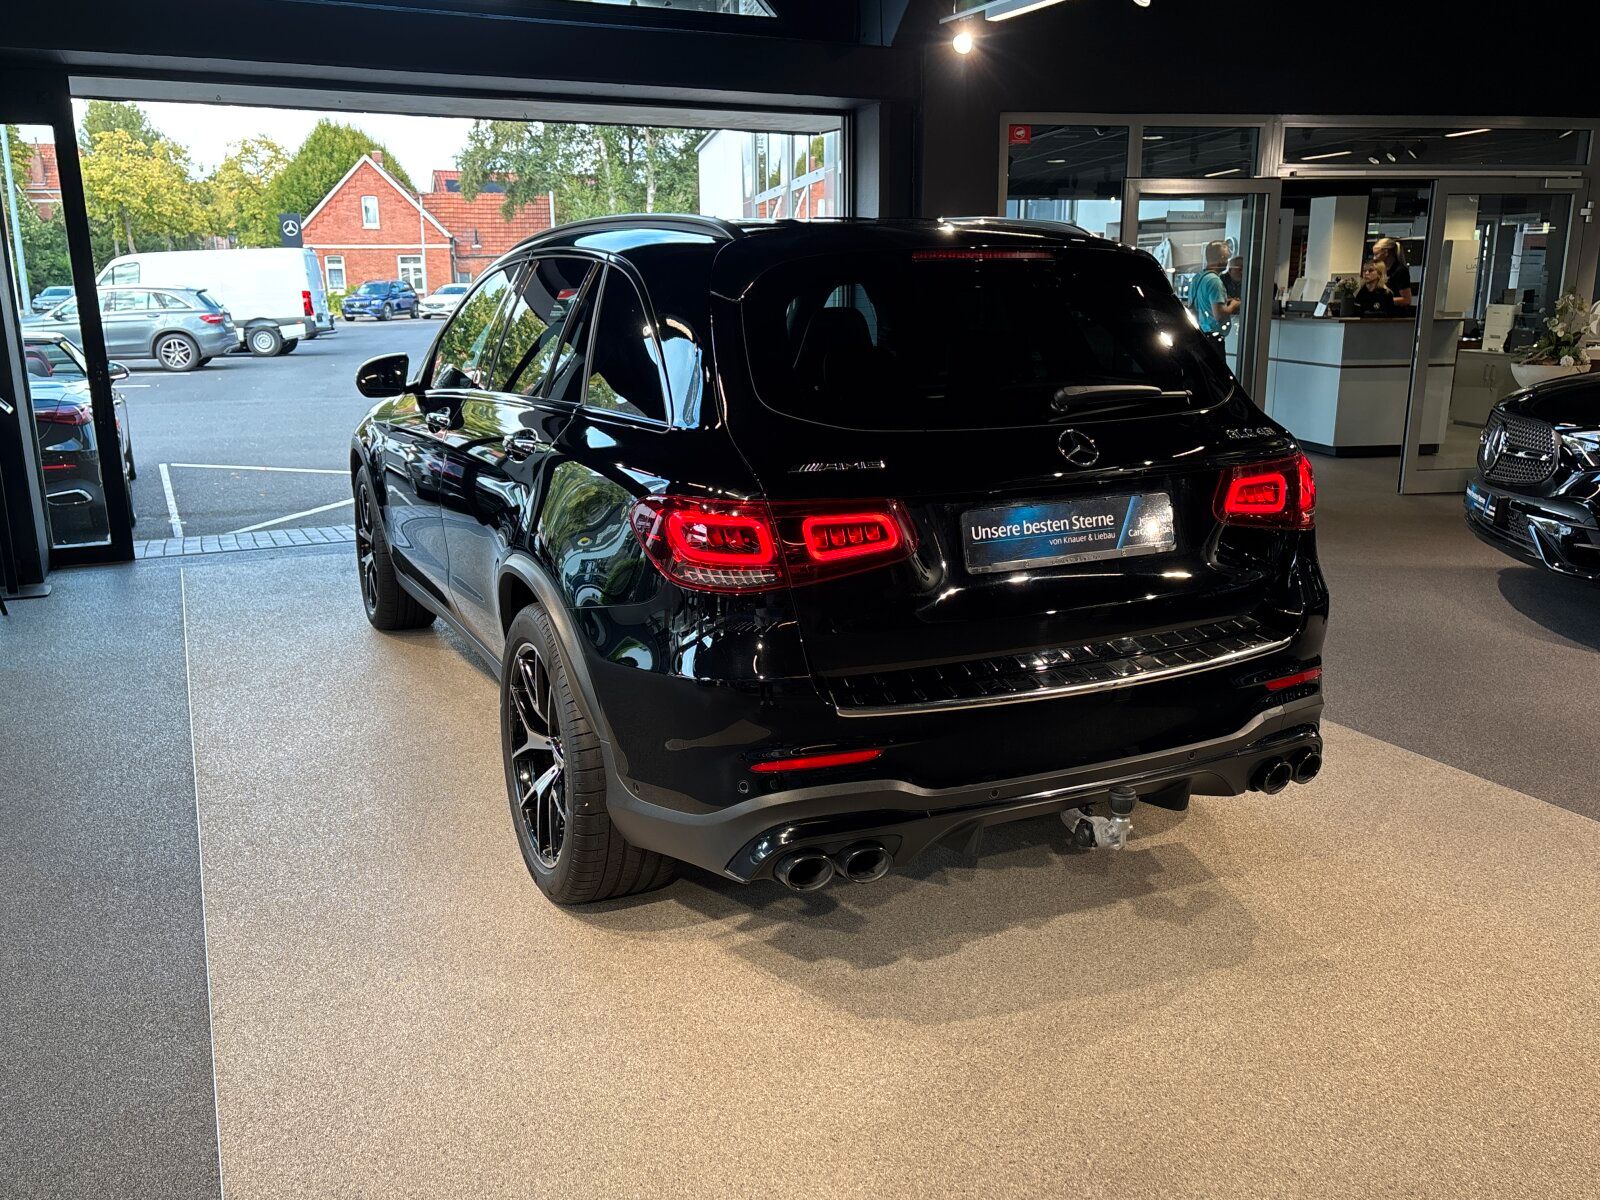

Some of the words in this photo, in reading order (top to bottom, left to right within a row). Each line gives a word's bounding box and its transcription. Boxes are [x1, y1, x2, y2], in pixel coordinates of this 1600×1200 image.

[971, 524, 1021, 541] Unsere
[1022, 518, 1070, 535] besten
[1071, 514, 1115, 530] Sterne
[1049, 538, 1063, 546] von
[1063, 535, 1087, 545] Knauer
[1087, 533, 1093, 541] &
[1094, 532, 1116, 541] Liebau
